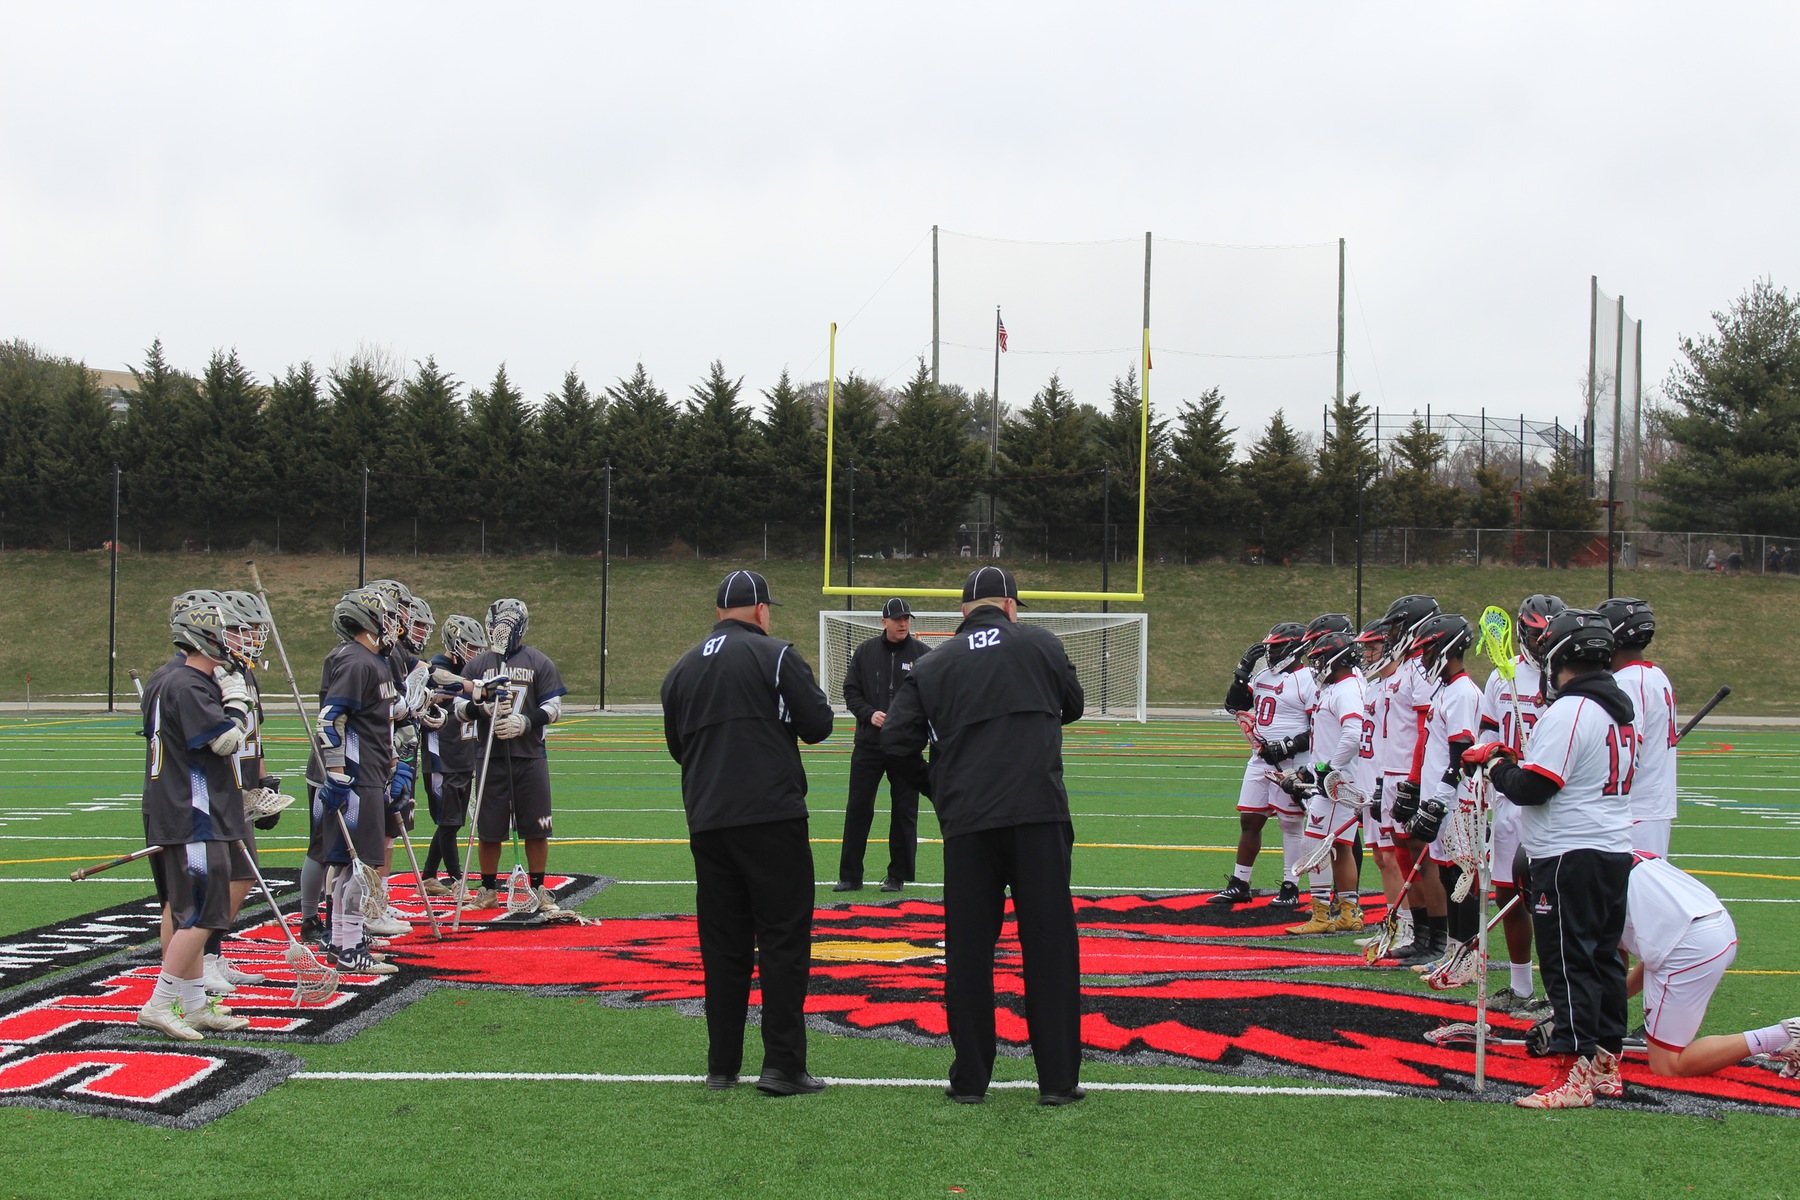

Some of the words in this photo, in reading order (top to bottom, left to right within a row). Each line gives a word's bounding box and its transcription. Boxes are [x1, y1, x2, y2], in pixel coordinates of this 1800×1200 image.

[189, 611, 222, 627] WT
[703, 635, 727, 657] 87
[967, 628, 1000, 650] 132
[482, 667, 534, 682] WILLAMSON
[1602, 723, 1636, 796] 17
